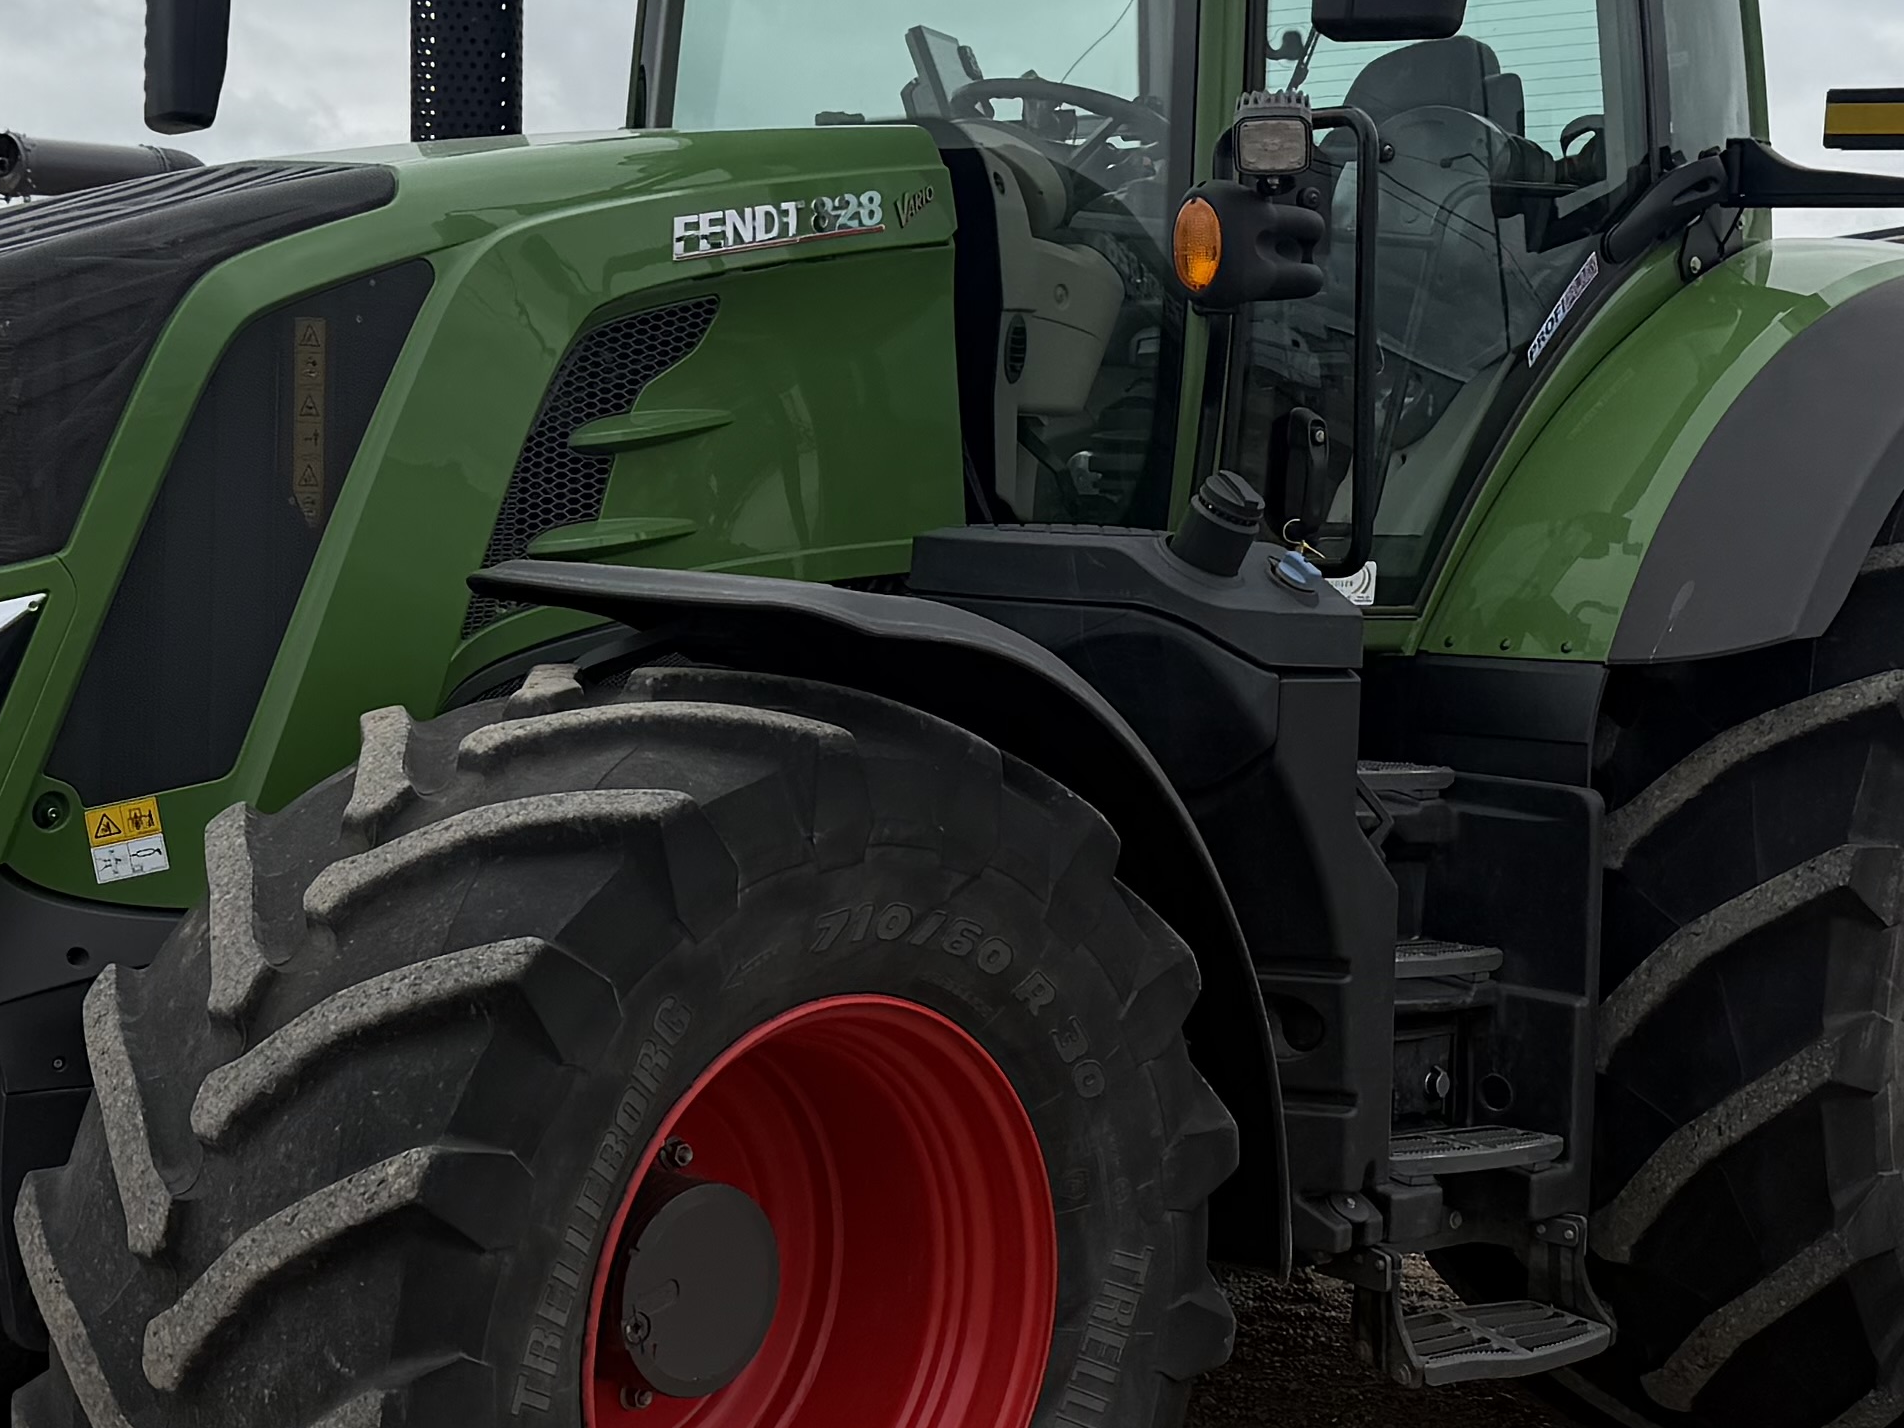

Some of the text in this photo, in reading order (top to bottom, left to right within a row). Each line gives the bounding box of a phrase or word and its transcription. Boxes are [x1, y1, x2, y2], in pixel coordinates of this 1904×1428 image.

[673, 185, 935, 256] FENDT 828 VARIO
[808, 901, 1015, 976] 710/60
[1010, 969, 1058, 1018] R
[1048, 1015, 1107, 1099] 30
[510, 993, 693, 1418] TRELLEBORG
